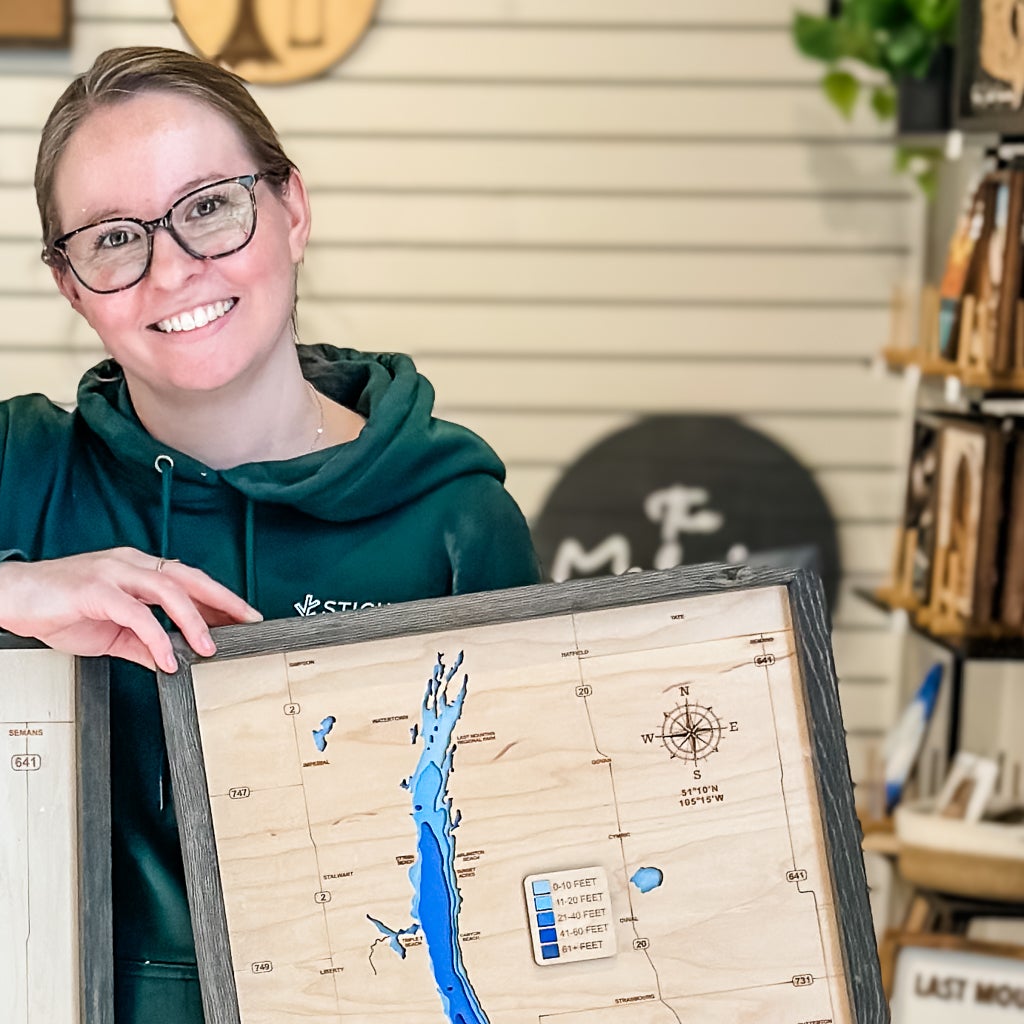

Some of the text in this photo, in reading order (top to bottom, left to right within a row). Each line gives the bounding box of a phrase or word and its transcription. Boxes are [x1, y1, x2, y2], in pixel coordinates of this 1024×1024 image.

[579, 687, 589, 695] 20
[681, 687, 689, 695] N
[290, 705, 295, 713] 2
[730, 722, 739, 731] E
[641, 734, 654, 743] W
[15, 757, 37, 768] 641
[694, 771, 701, 780] S
[231, 789, 247, 798] 747
[789, 872, 804, 880] 641
[553, 878, 596, 891] 0-10 FEET
[581, 893, 603, 903] FEET
[583, 909, 605, 918] FEET
[586, 924, 608, 934] FEET
[580, 941, 603, 950] FEET
[636, 940, 647, 948] 20
[254, 963, 270, 971] 749
[795, 976, 811, 985] 731
